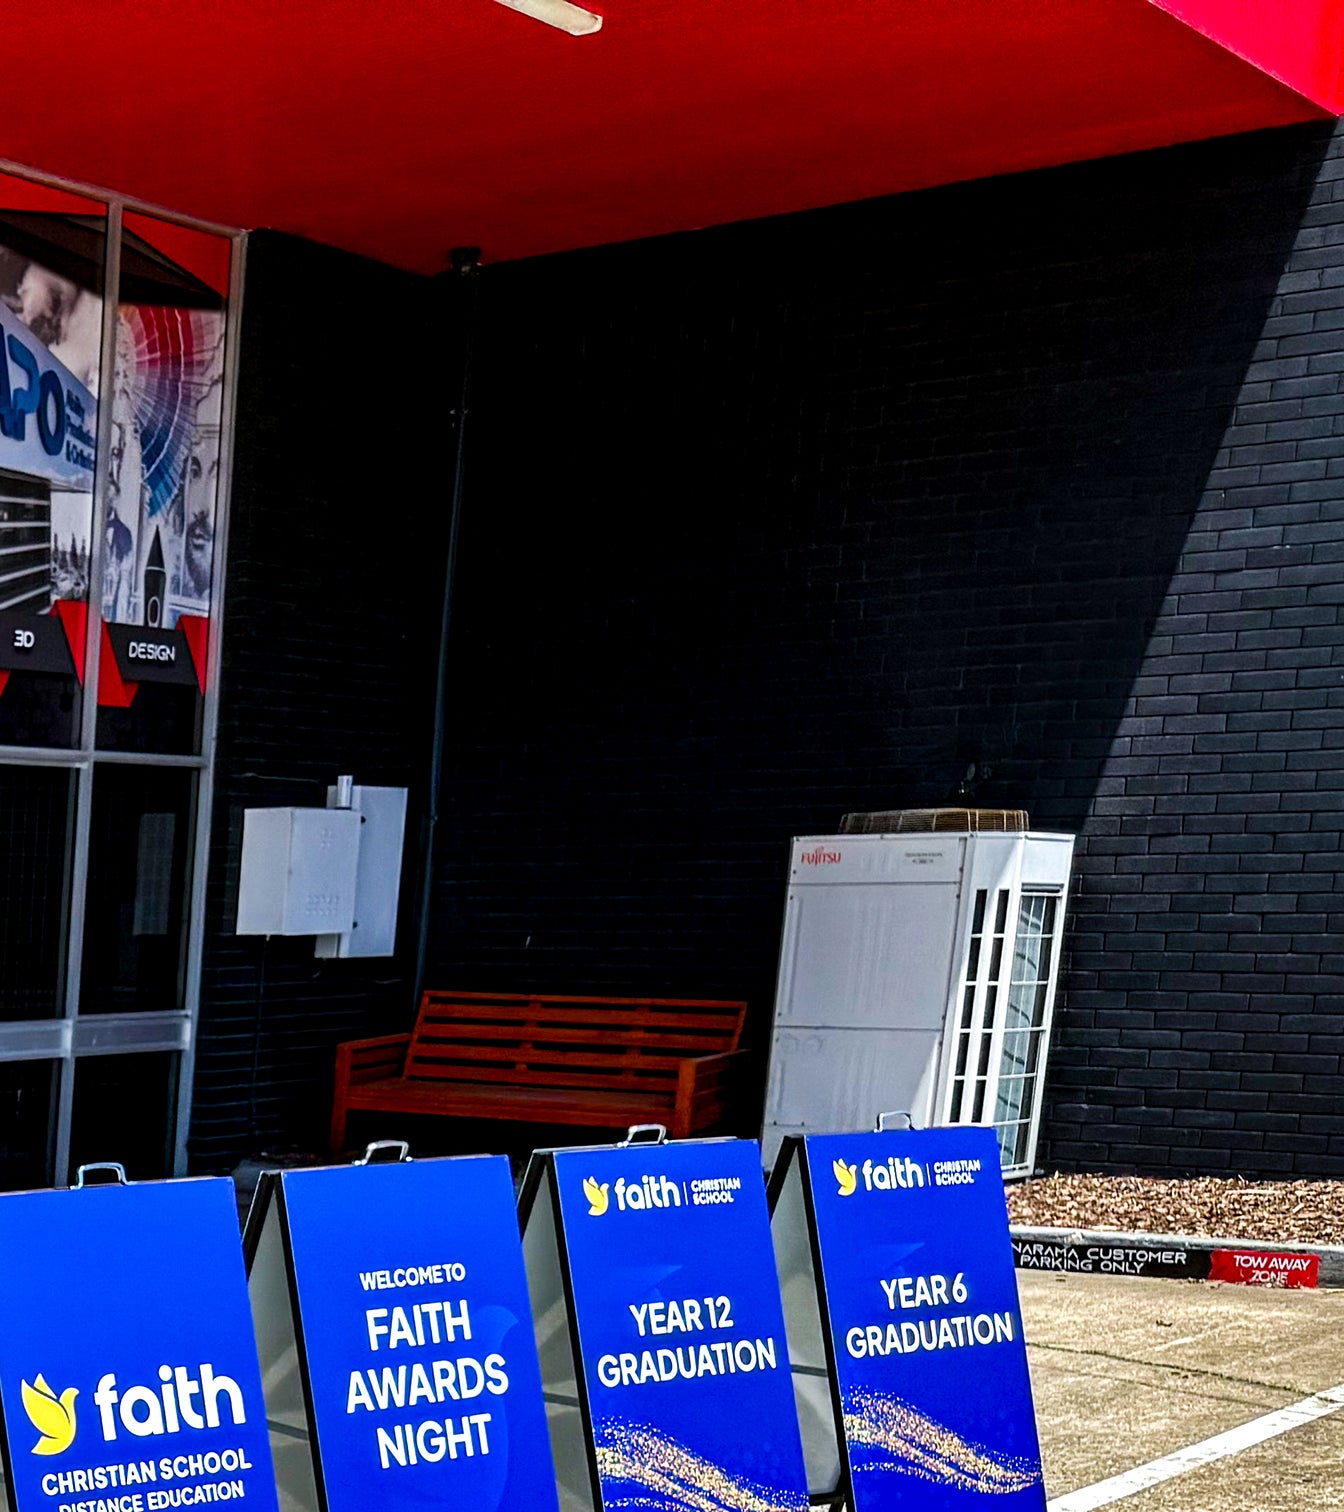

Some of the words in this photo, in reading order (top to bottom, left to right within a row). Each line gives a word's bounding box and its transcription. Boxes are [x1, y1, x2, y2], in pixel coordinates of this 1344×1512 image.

[14, 630, 35, 649] 3D
[128, 640, 176, 661] DESIGN
[801, 846, 841, 866] FUJITSU
[862, 1156, 924, 1192] faith
[933, 1159, 981, 1173] CHRISTIAN
[935, 1172, 975, 1186] SCHOOL
[614, 1174, 681, 1211] faith
[690, 1177, 741, 1193] CHRISTIAN
[692, 1191, 734, 1205] SCHOOL
[1020, 1254, 1092, 1272] PARKING
[1100, 1260, 1145, 1274] ONLY
[1087, 1247, 1187, 1265] CUSTOMER
[1234, 1255, 1269, 1269] TOW
[1270, 1257, 1311, 1272] AWAY
[360, 1265, 444, 1291] WELCOME
[444, 1262, 466, 1283] TO
[880, 1274, 949, 1310] YEAR
[952, 1272, 969, 1303] 6
[1251, 1270, 1288, 1283] ZONE
[366, 1299, 472, 1351] FAITH
[629, 1298, 704, 1337] YEAR
[704, 1295, 734, 1329] 12
[846, 1311, 1014, 1359] GRADUATION
[597, 1337, 777, 1388] GRADUATION
[346, 1353, 509, 1414] AWARDS
[94, 1363, 246, 1441] faith
[376, 1413, 492, 1470] NIGHT
[41, 1460, 157, 1496] CHRISTIAN
[160, 1448, 253, 1481] SCHOOL
[147, 1479, 245, 1511] EDUCATION
